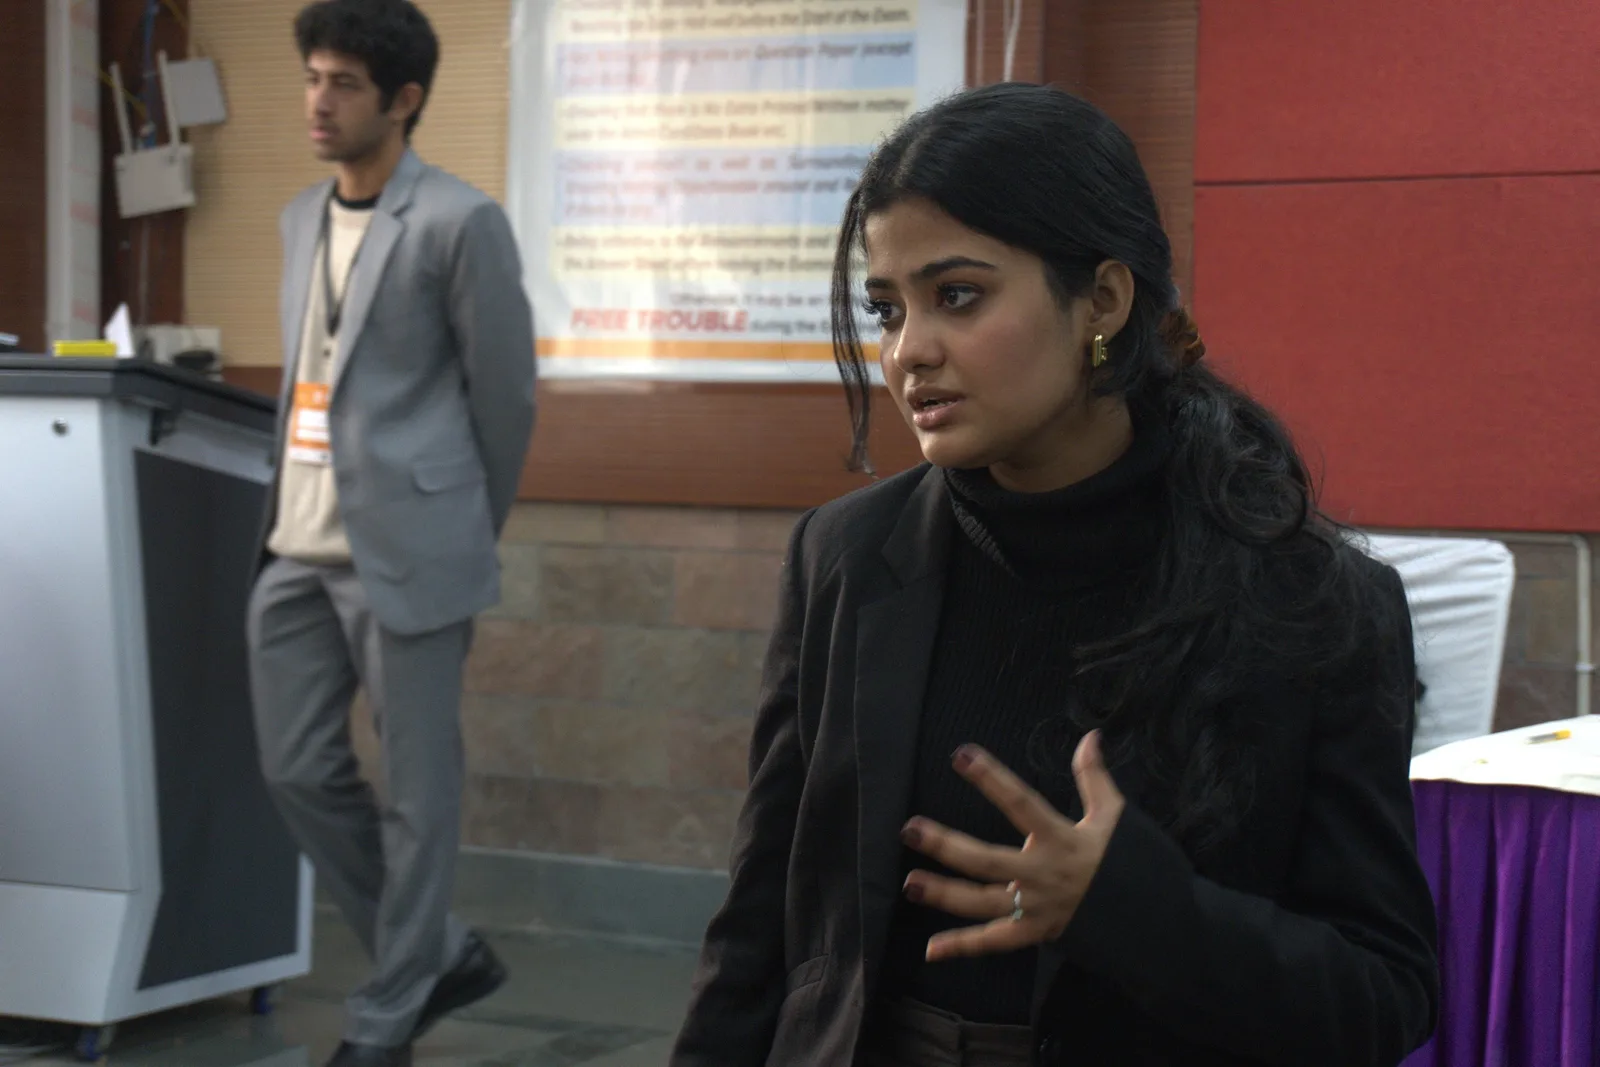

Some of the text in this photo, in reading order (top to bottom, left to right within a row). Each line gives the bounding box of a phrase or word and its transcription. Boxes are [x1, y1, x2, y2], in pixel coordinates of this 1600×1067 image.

[851, 9, 870, 23] the
[570, 308, 628, 331] FREE
[637, 308, 748, 333] TROUBLE
[752, 320, 793, 335] during
[795, 320, 817, 332] the
